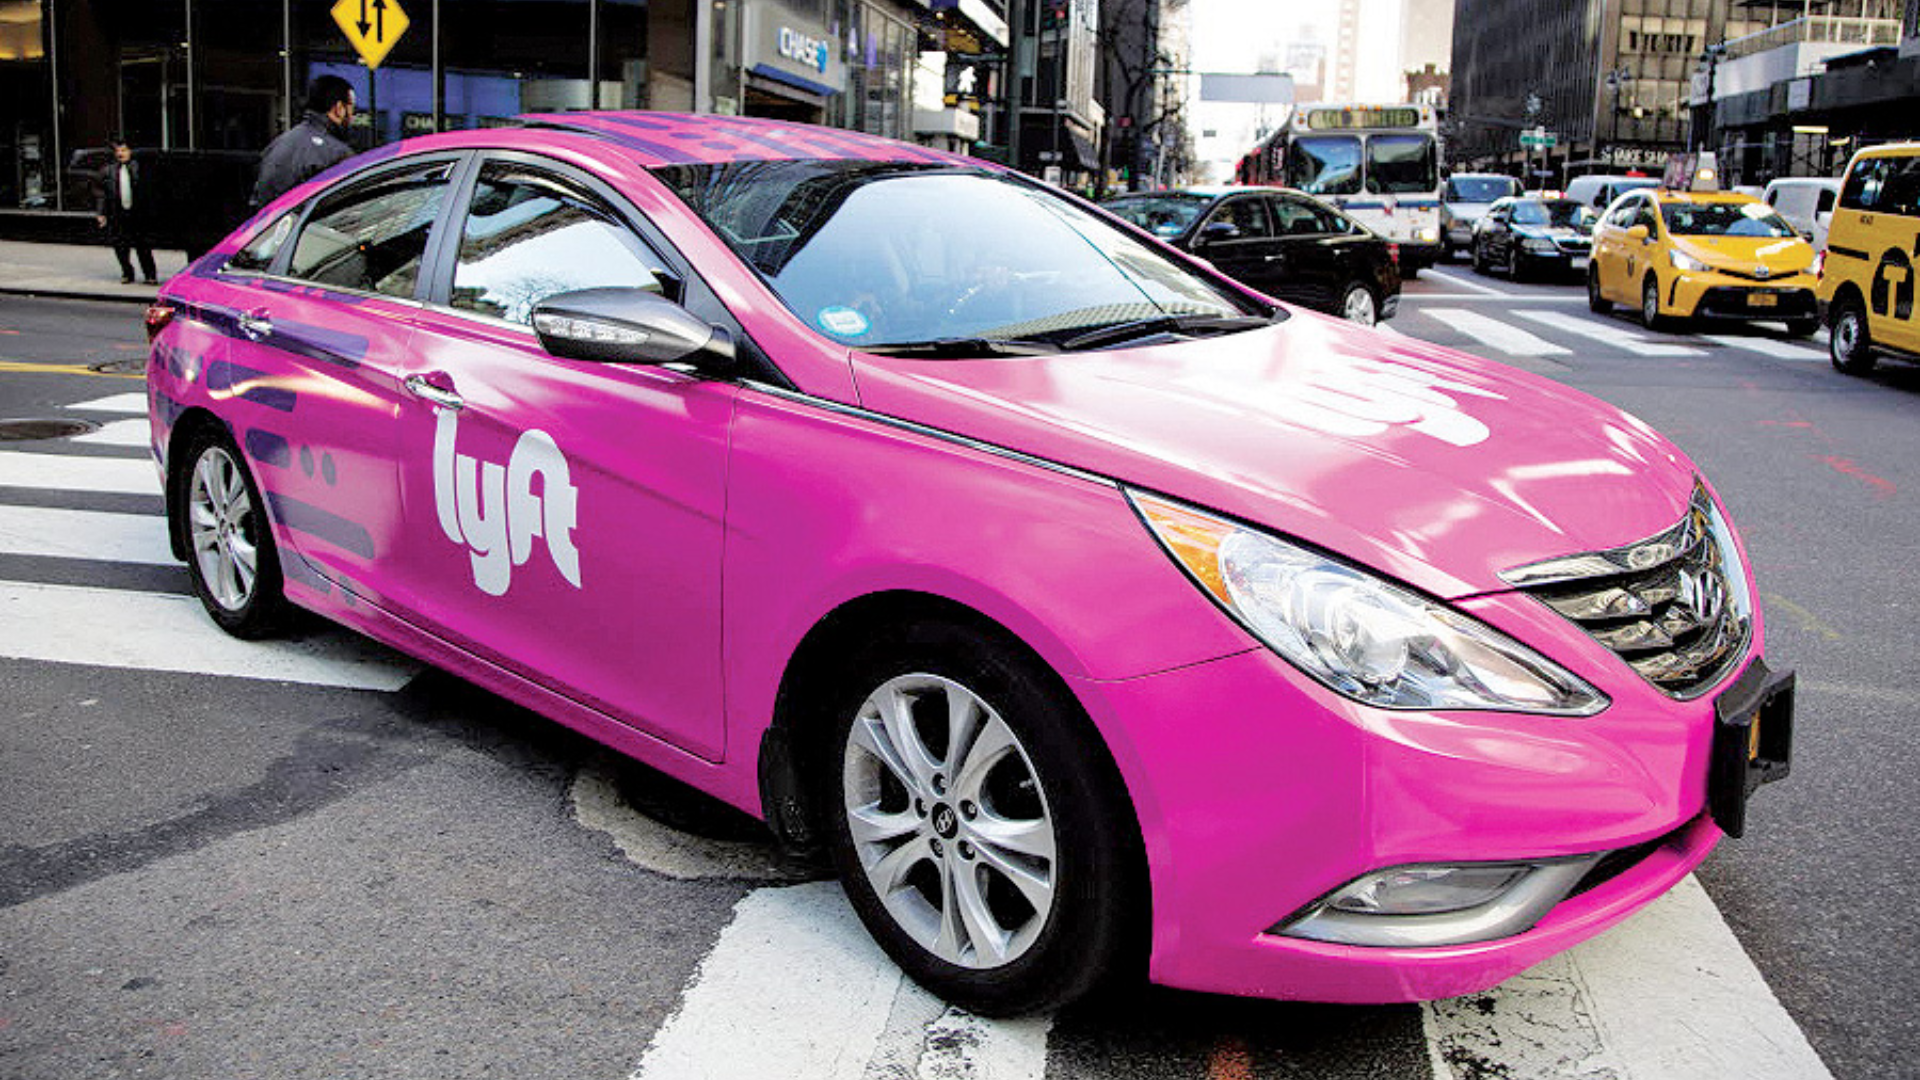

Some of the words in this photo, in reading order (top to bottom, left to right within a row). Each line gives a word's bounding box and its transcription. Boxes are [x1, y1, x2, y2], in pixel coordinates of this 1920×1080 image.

[778, 27, 820, 67] CHASE
[405, 114, 454, 130] CHAE
[432, 406, 582, 596] lyft
